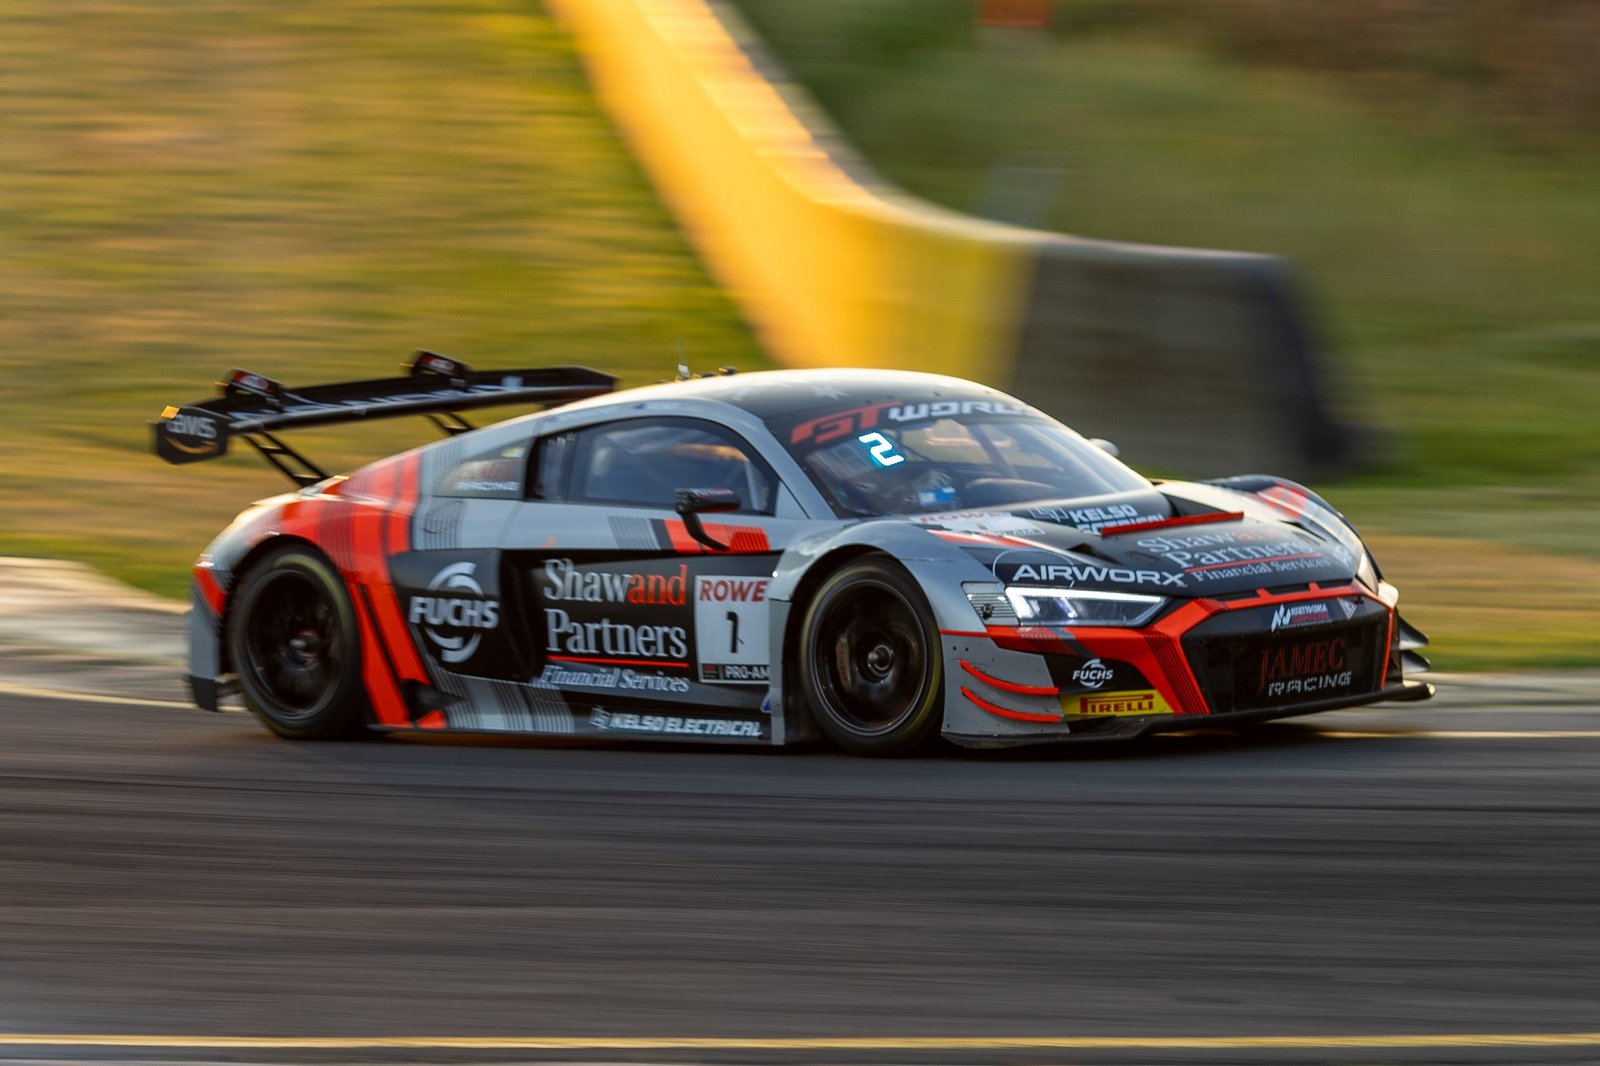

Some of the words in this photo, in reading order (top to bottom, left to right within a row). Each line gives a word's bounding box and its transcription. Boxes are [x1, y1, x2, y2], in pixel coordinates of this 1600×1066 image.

[858, 432, 905, 466] 2
[1068, 504, 1138, 523] KELSO
[1160, 541, 1314, 569] Partners
[1012, 564, 1185, 585] AIRWORX
[1190, 563, 1272, 582] Financial
[700, 579, 769, 602] ROWE
[408, 596, 499, 629] FUCHS
[544, 608, 688, 659] Partners
[726, 611, 739, 653] 1
[539, 665, 621, 688] Financial
[619, 668, 690, 692] Services
[1072, 669, 1114, 680] FUCHS
[1256, 637, 1344, 696] JAMEC
[1268, 671, 1352, 696] RACING
[1080, 694, 1154, 713] PIRELLI
[609, 713, 666, 732] KELSO
[665, 716, 764, 737] ELECTRICAL
